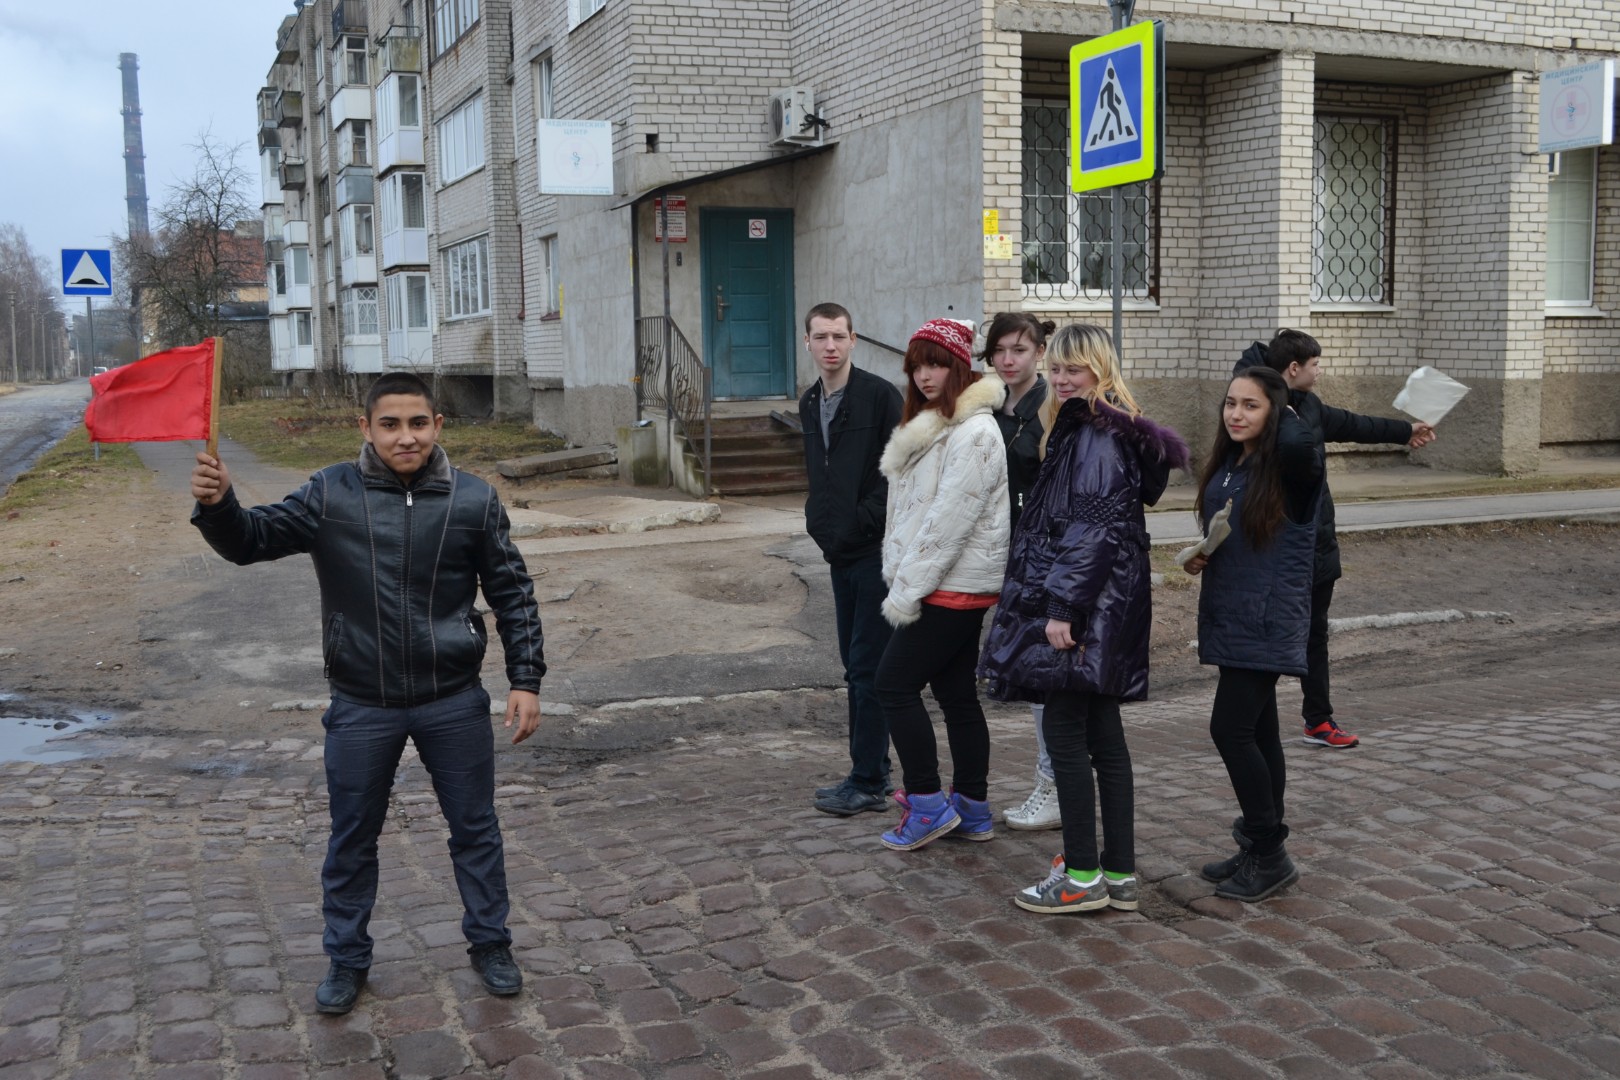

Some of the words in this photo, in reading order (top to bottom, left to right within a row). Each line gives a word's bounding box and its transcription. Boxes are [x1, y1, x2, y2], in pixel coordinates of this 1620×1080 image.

[1545, 63, 1600, 80] МЕДИЦИНСКИЙ
[1561, 75, 1583, 85] ЦЕНТР
[545, 120, 606, 128] МЕДИЦИНСКИЙ
